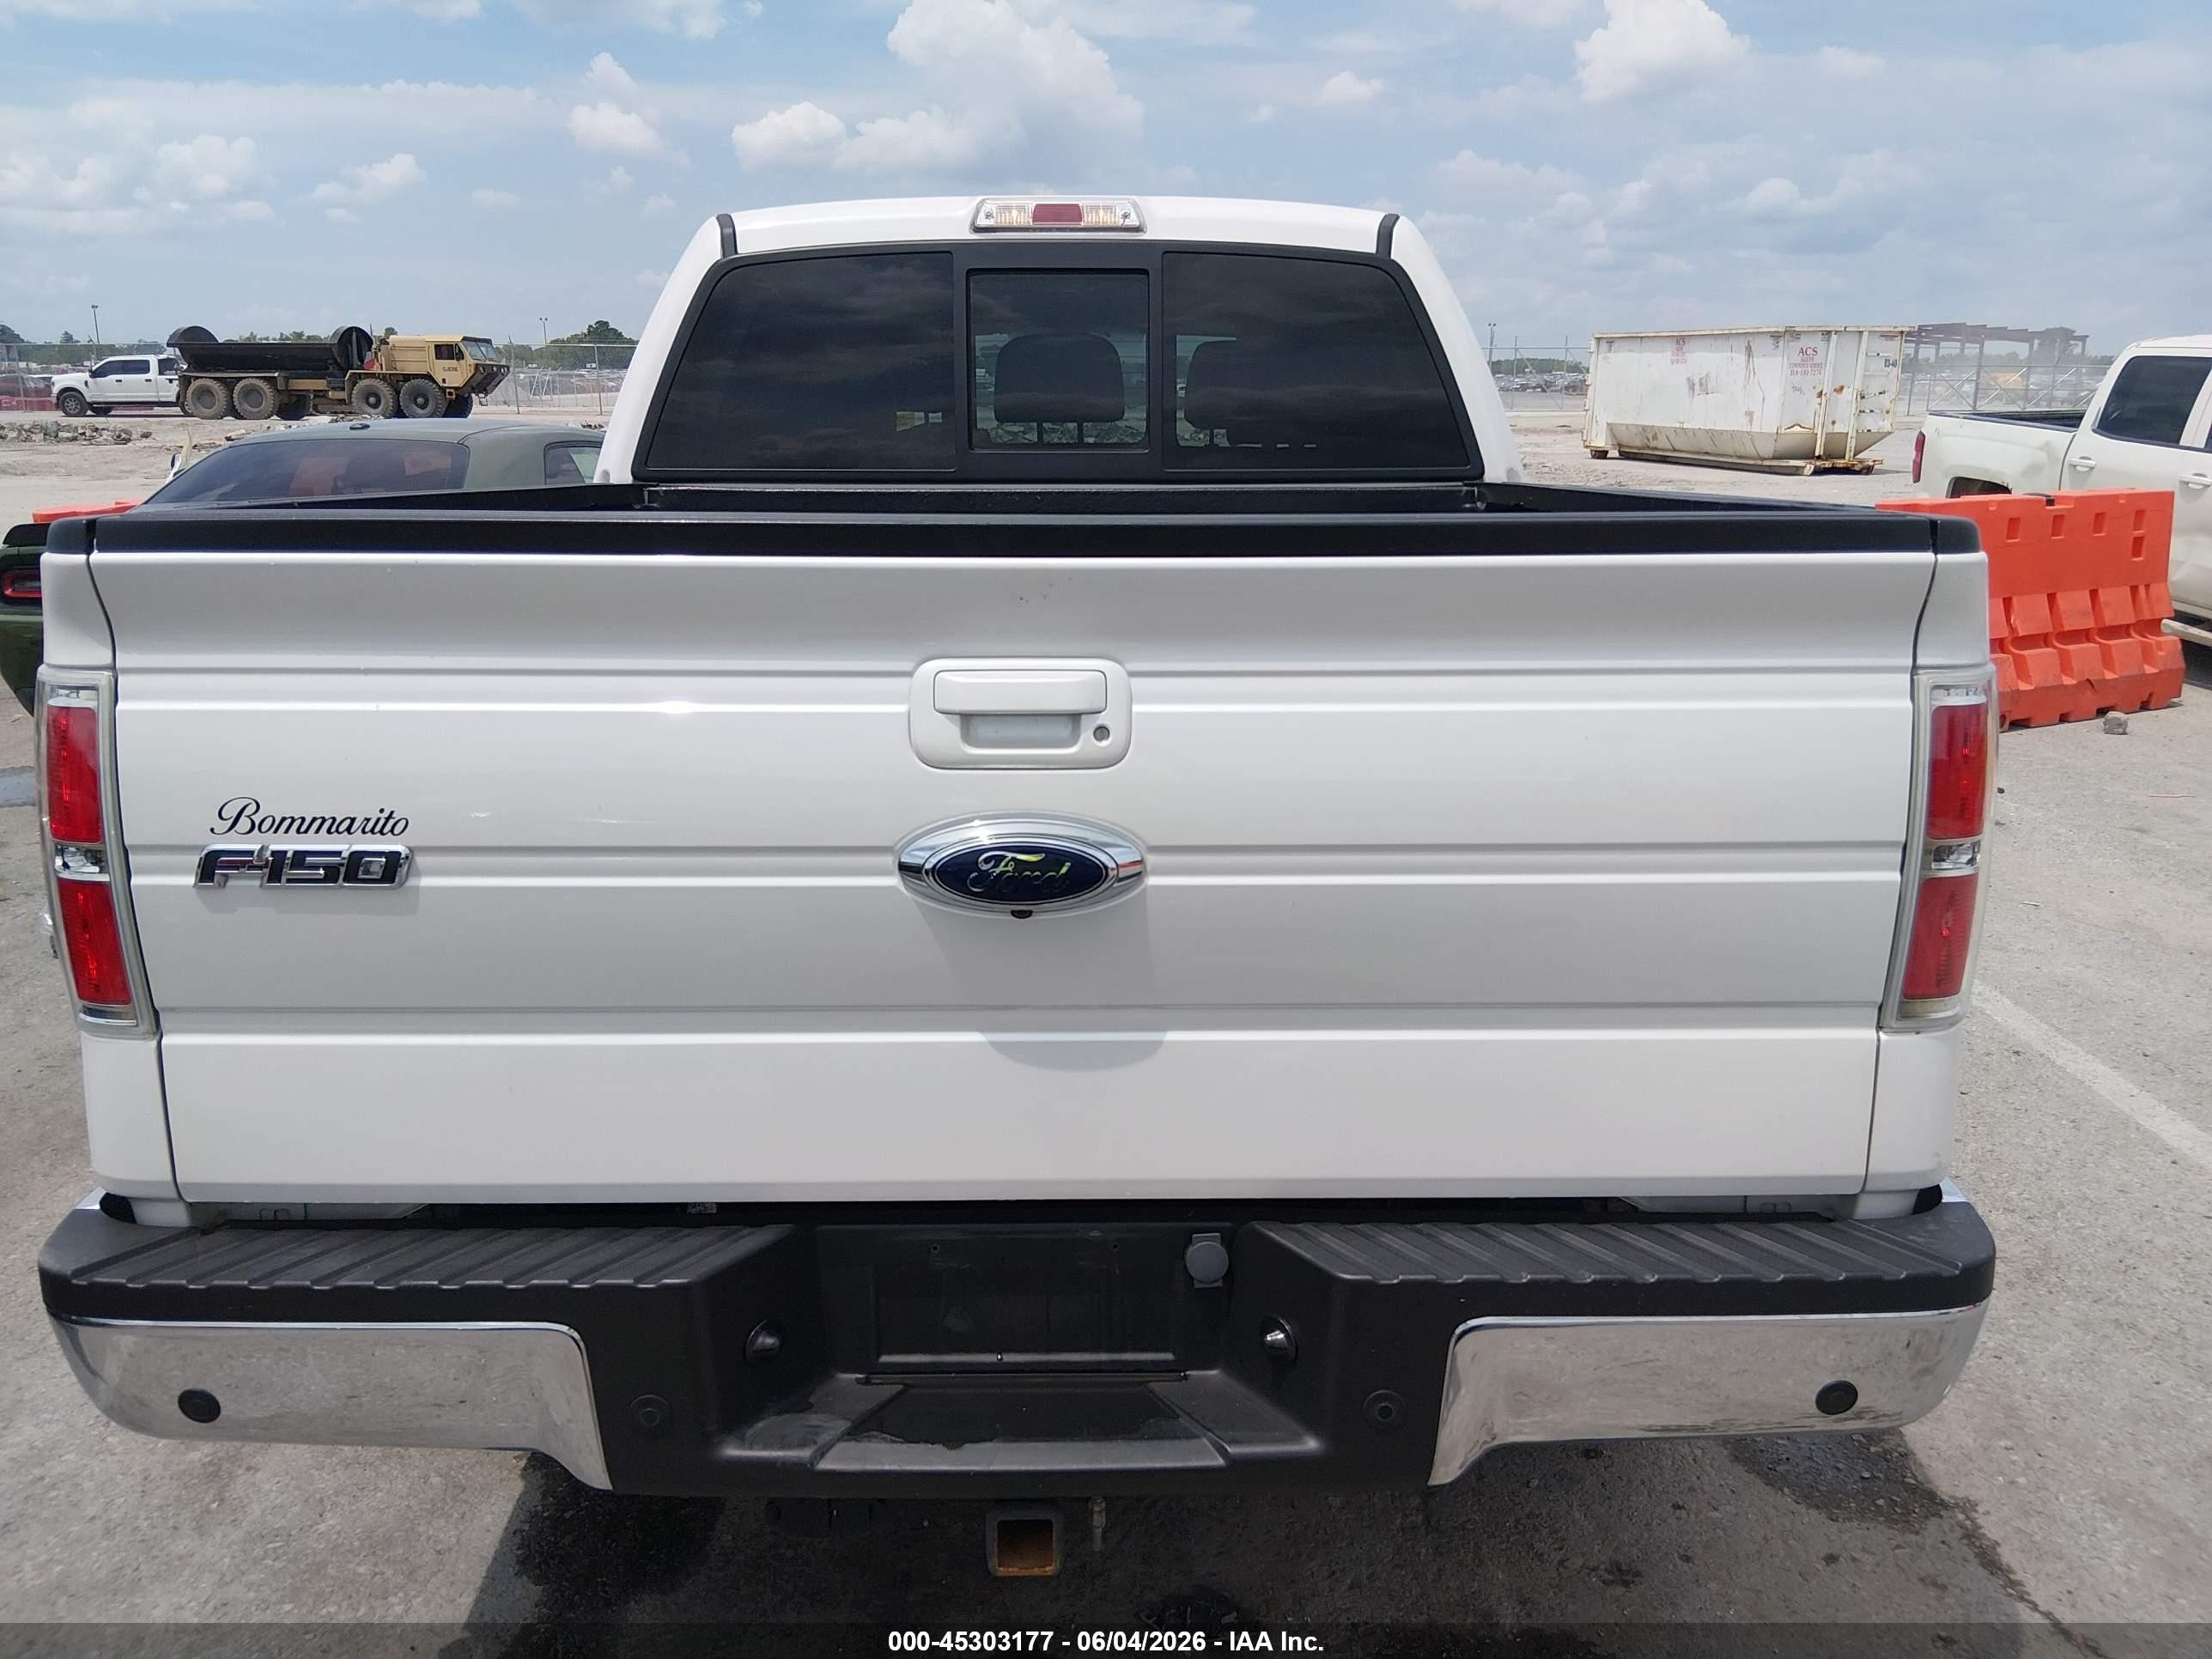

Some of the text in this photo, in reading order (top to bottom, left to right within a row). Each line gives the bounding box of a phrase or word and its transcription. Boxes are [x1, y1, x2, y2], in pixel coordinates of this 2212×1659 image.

[1798, 347, 1818, 356] ACS
[210, 796, 409, 836] Bommarito
[193, 844, 414, 889] F-150
[967, 850, 1071, 893] Ford
